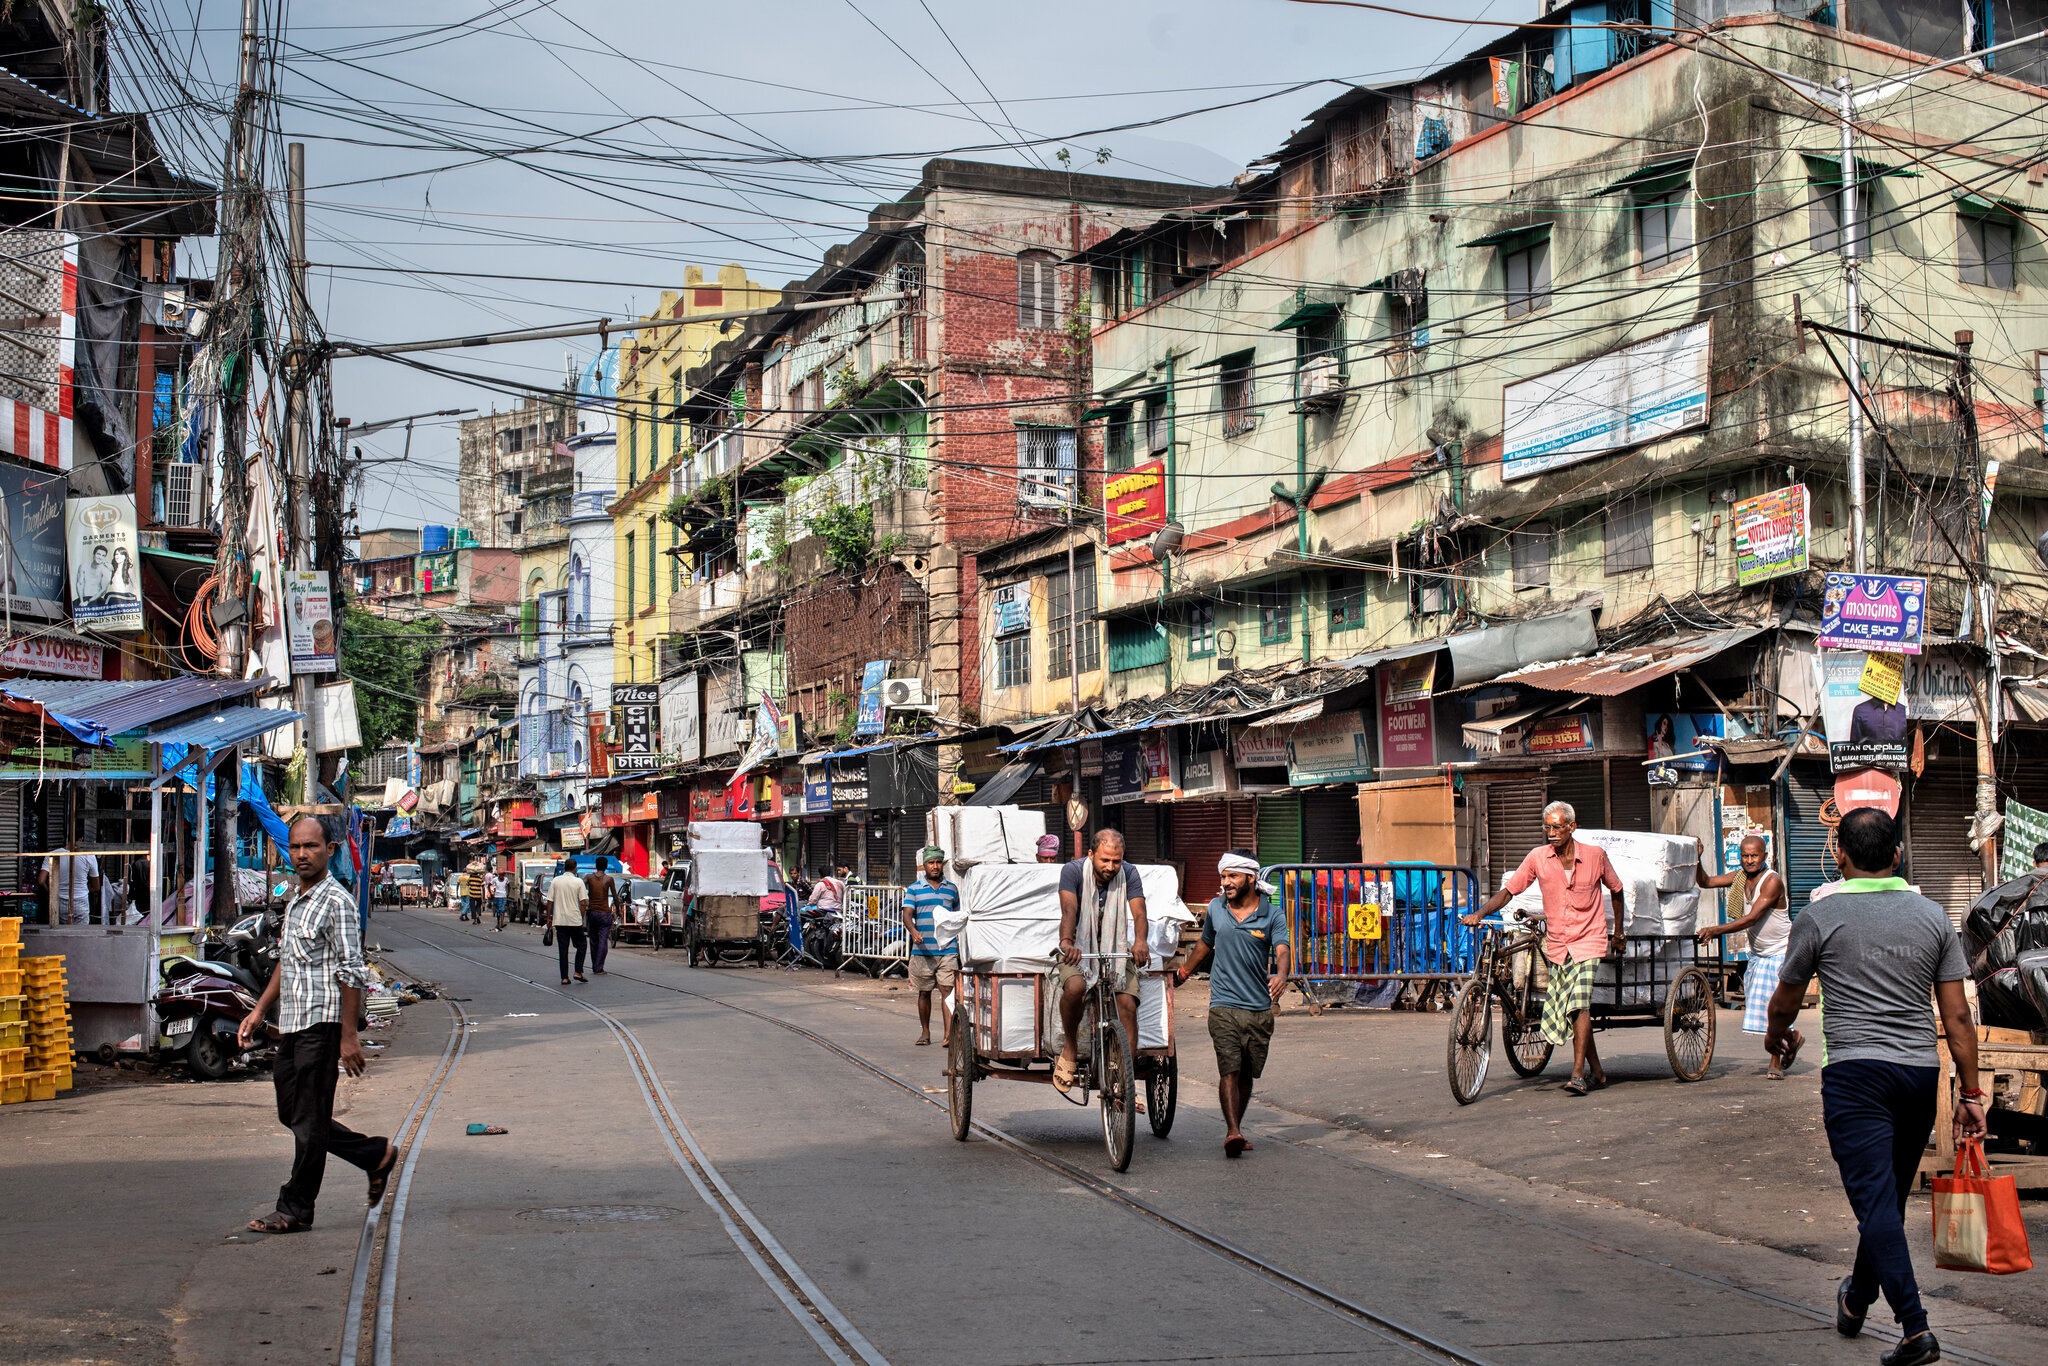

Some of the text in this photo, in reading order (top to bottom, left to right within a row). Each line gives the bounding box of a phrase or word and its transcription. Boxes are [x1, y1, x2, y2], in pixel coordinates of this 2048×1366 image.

[1511, 437, 1544, 450] DEALERS
[1558, 423, 1583, 436] DRUGS
[82, 532, 126, 541] GARMENTS
[1747, 515, 1793, 545] NOVELTY STORES
[290, 582, 306, 595] Haji
[14, 600, 32, 611] STORES
[111, 613, 141, 622] STORES
[1843, 622, 1869, 634] CAKE
[1870, 624, 1899, 637] SHOP
[36, 638, 91, 663] STORES
[1836, 667, 1861, 676] STEPS
[1923, 663, 1971, 702] Opticals
[613, 685, 657, 702] Nice
[627, 706, 648, 752] CHINA
[1388, 712, 1426, 731] FOOTWEAR
[1236, 731, 1265, 763] Jyoti
[1839, 743, 1903, 753] TITAN eyeplus
[1184, 762, 1212, 780] AIRCEL
[1689, 762, 1705, 770] PRASAD
